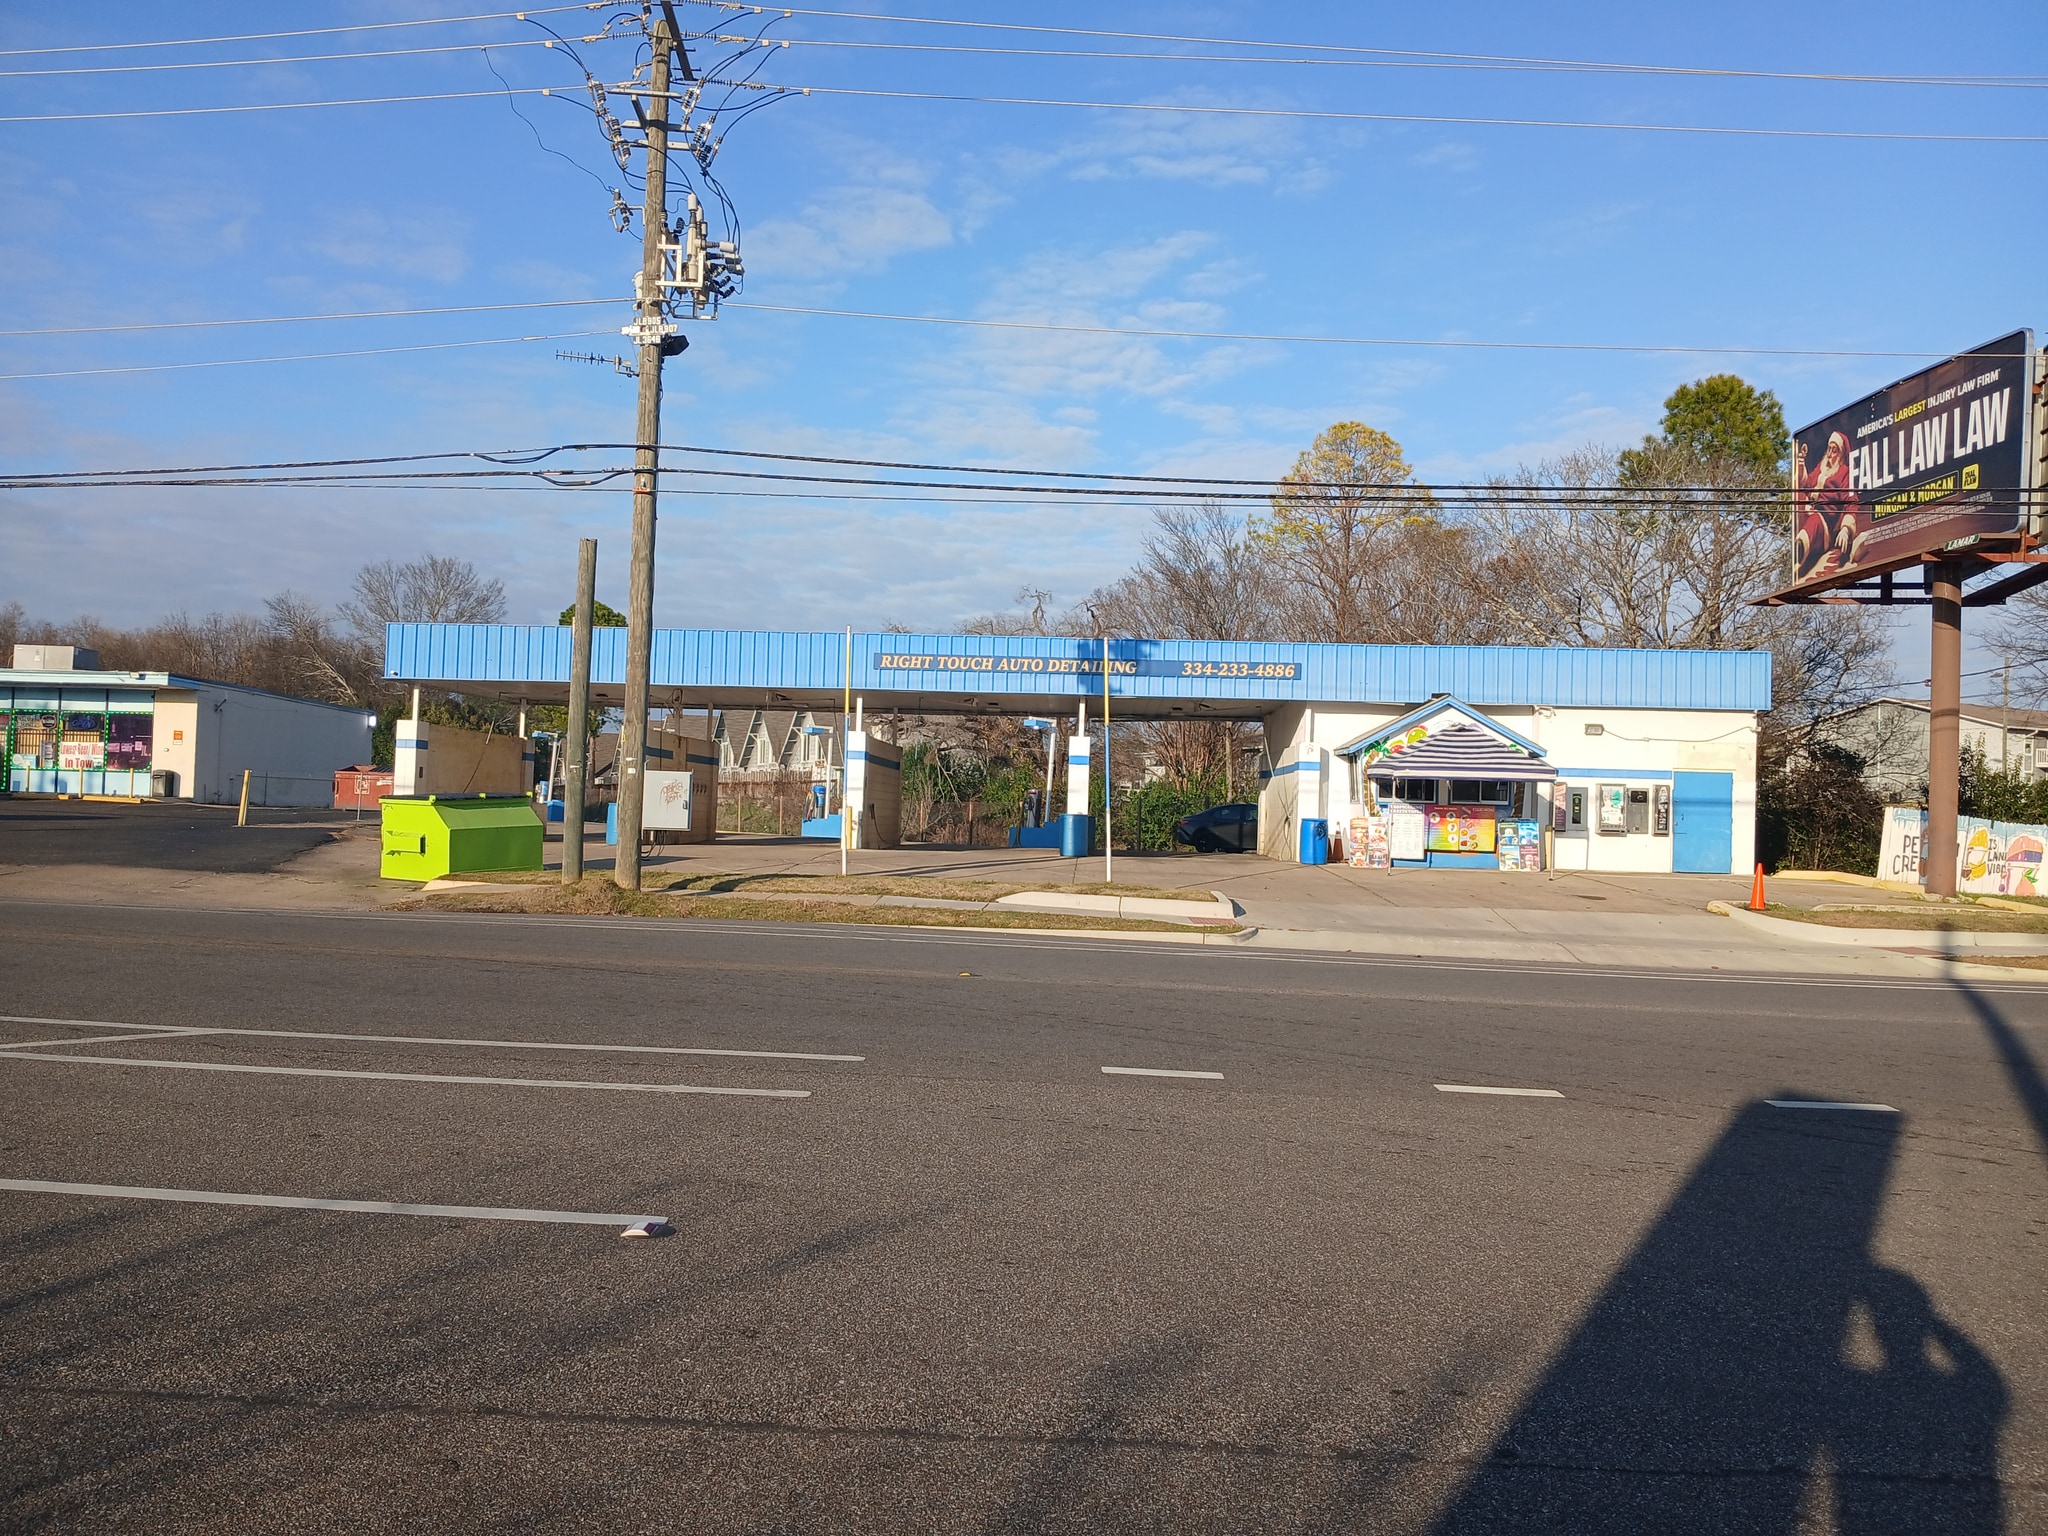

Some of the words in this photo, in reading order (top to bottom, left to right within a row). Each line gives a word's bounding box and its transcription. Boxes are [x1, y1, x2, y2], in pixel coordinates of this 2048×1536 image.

[1856, 413, 1894, 439] AMERICA'S
[1894, 399, 1927, 423] LARGEST
[1927, 386, 1957, 408] INJURY
[1957, 379, 1976, 397] LAW
[1976, 368, 2001, 388] FIRM
[1848, 437, 1895, 497] FALL
[1898, 412, 1949, 480] LAW
[1953, 386, 2010, 459] LAW
[1917, 475, 1956, 502] MORGAN
[1948, 535, 1976, 551] LAMAR
[879, 655, 934, 669] RIGHT
[937, 656, 994, 671] TOUCH
[996, 658, 1044, 673] AUTO
[1047, 659, 1137, 674] DETAILING
[1181, 662, 1295, 678] 334-233-4886
[1892, 854, 1919, 875] CRE
